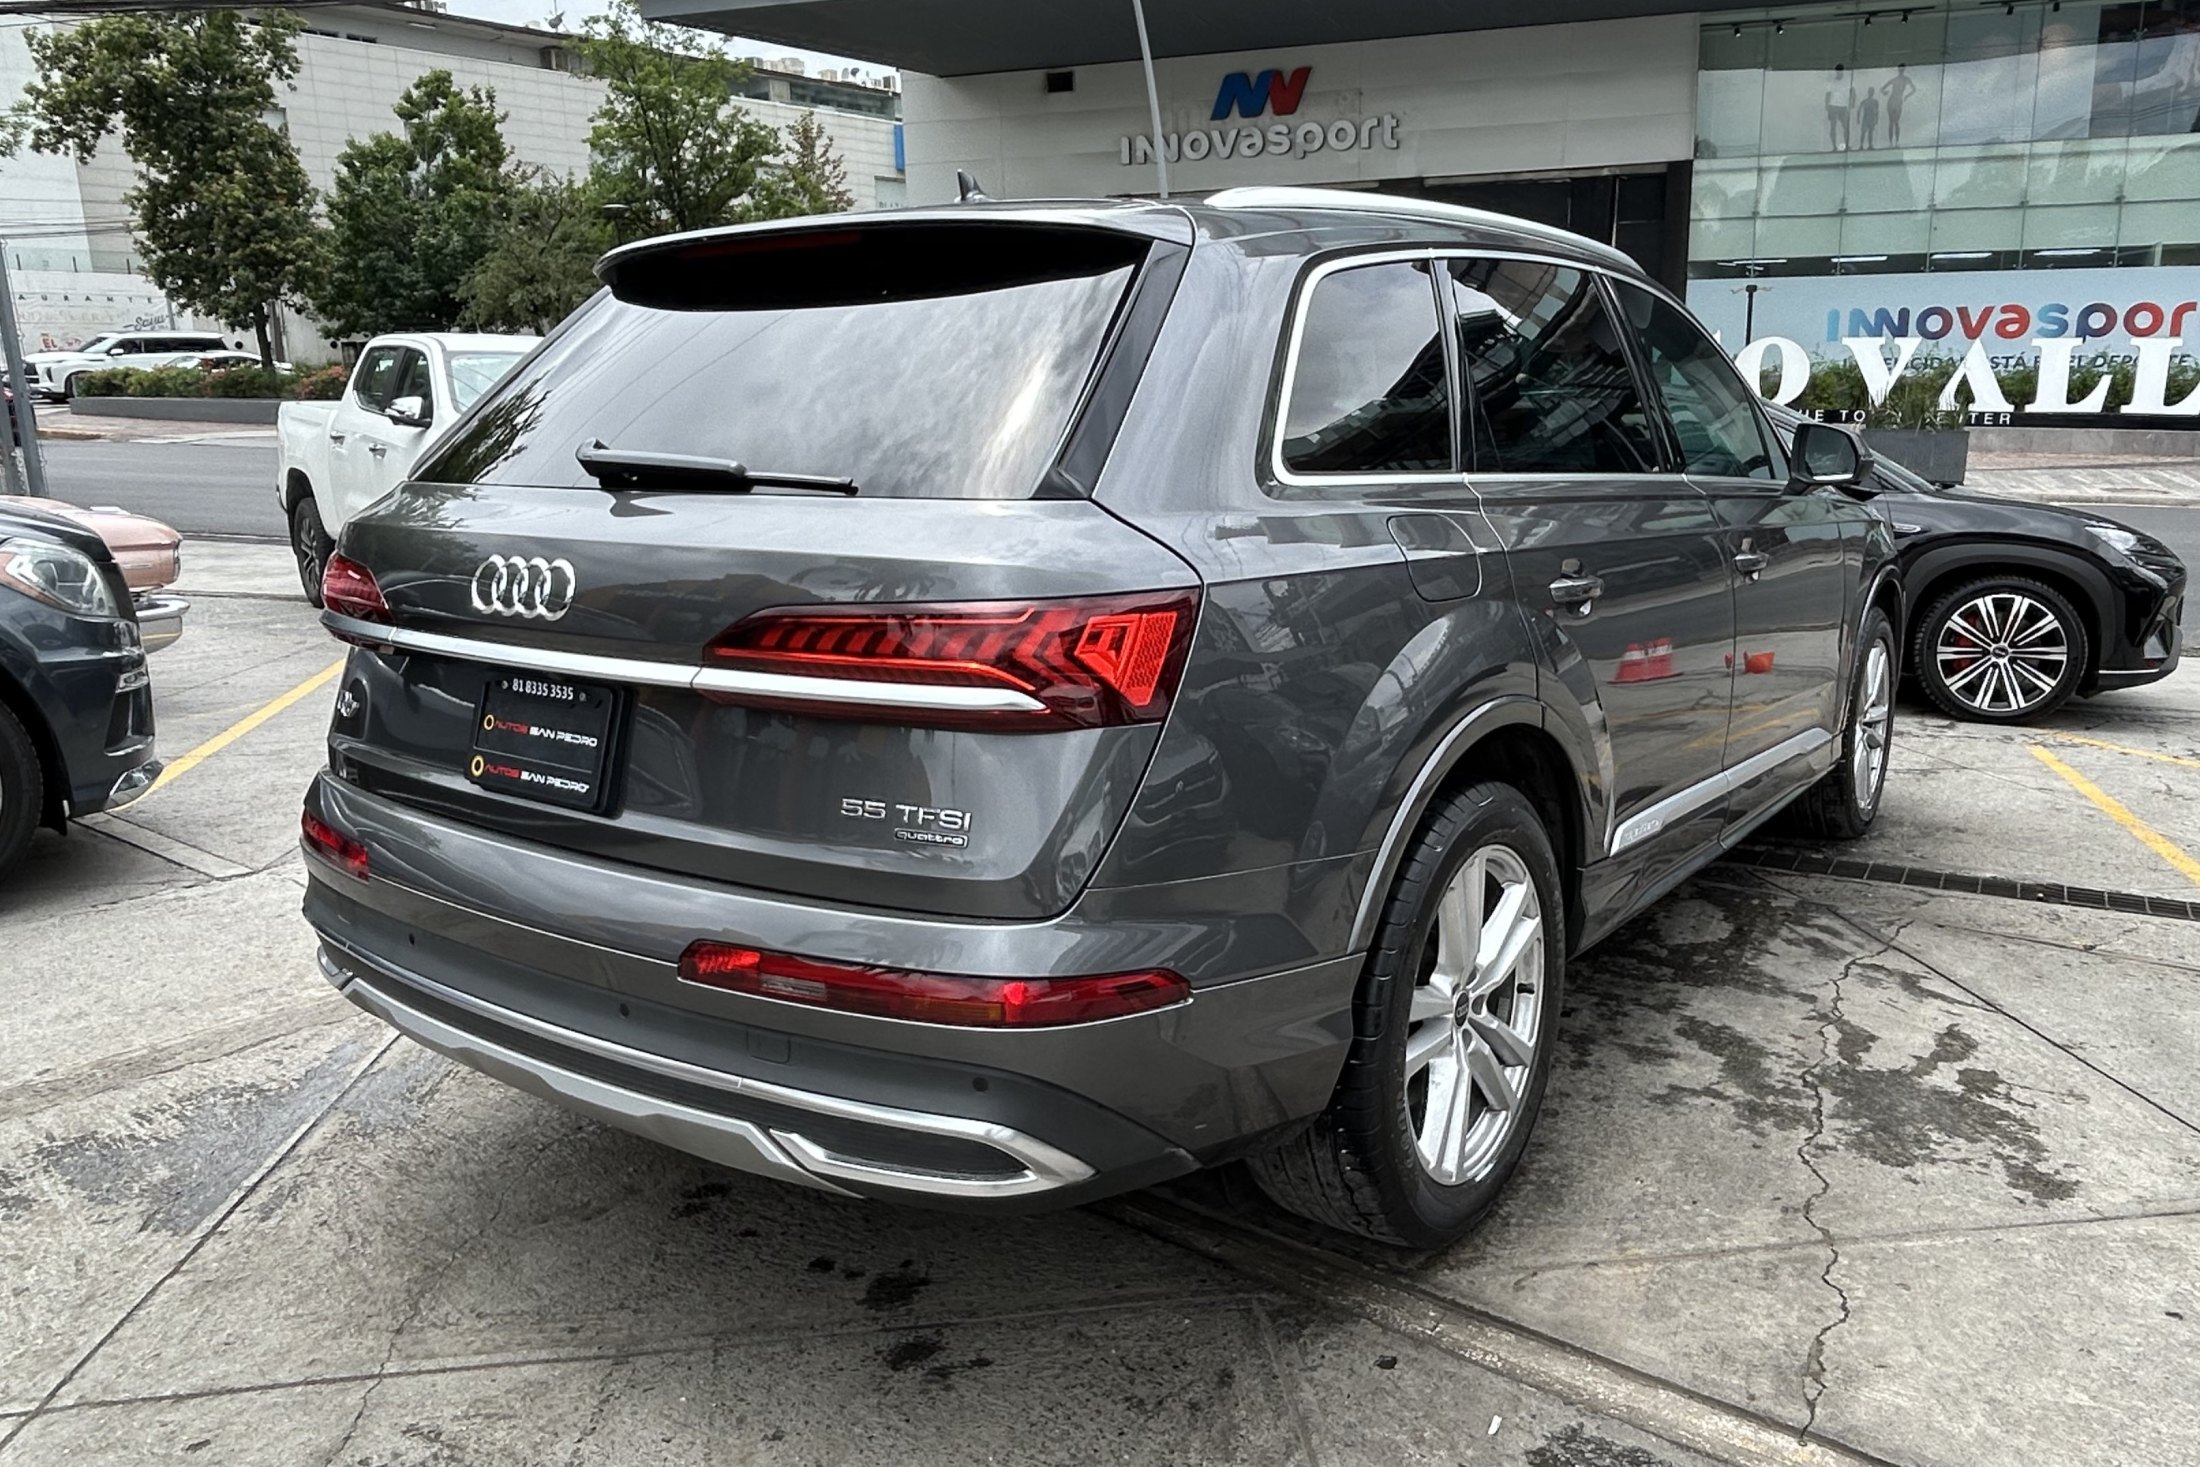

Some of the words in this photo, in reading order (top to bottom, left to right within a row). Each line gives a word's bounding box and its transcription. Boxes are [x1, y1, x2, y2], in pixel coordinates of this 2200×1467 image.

[1989, 350, 2027, 370] STÁ
[512, 678, 524, 692] 81
[525, 680, 548, 697] 8335
[550, 684, 574, 700] 3535
[495, 720, 528, 733] AUTOS
[529, 726, 555, 739] SAN
[556, 731, 598, 747] PEDRO
[485, 764, 520, 778] AUTOS
[521, 771, 546, 784] SAN
[840, 798, 887, 820] 55
[895, 803, 973, 832] TFSI
[898, 831, 963, 845] quattro
